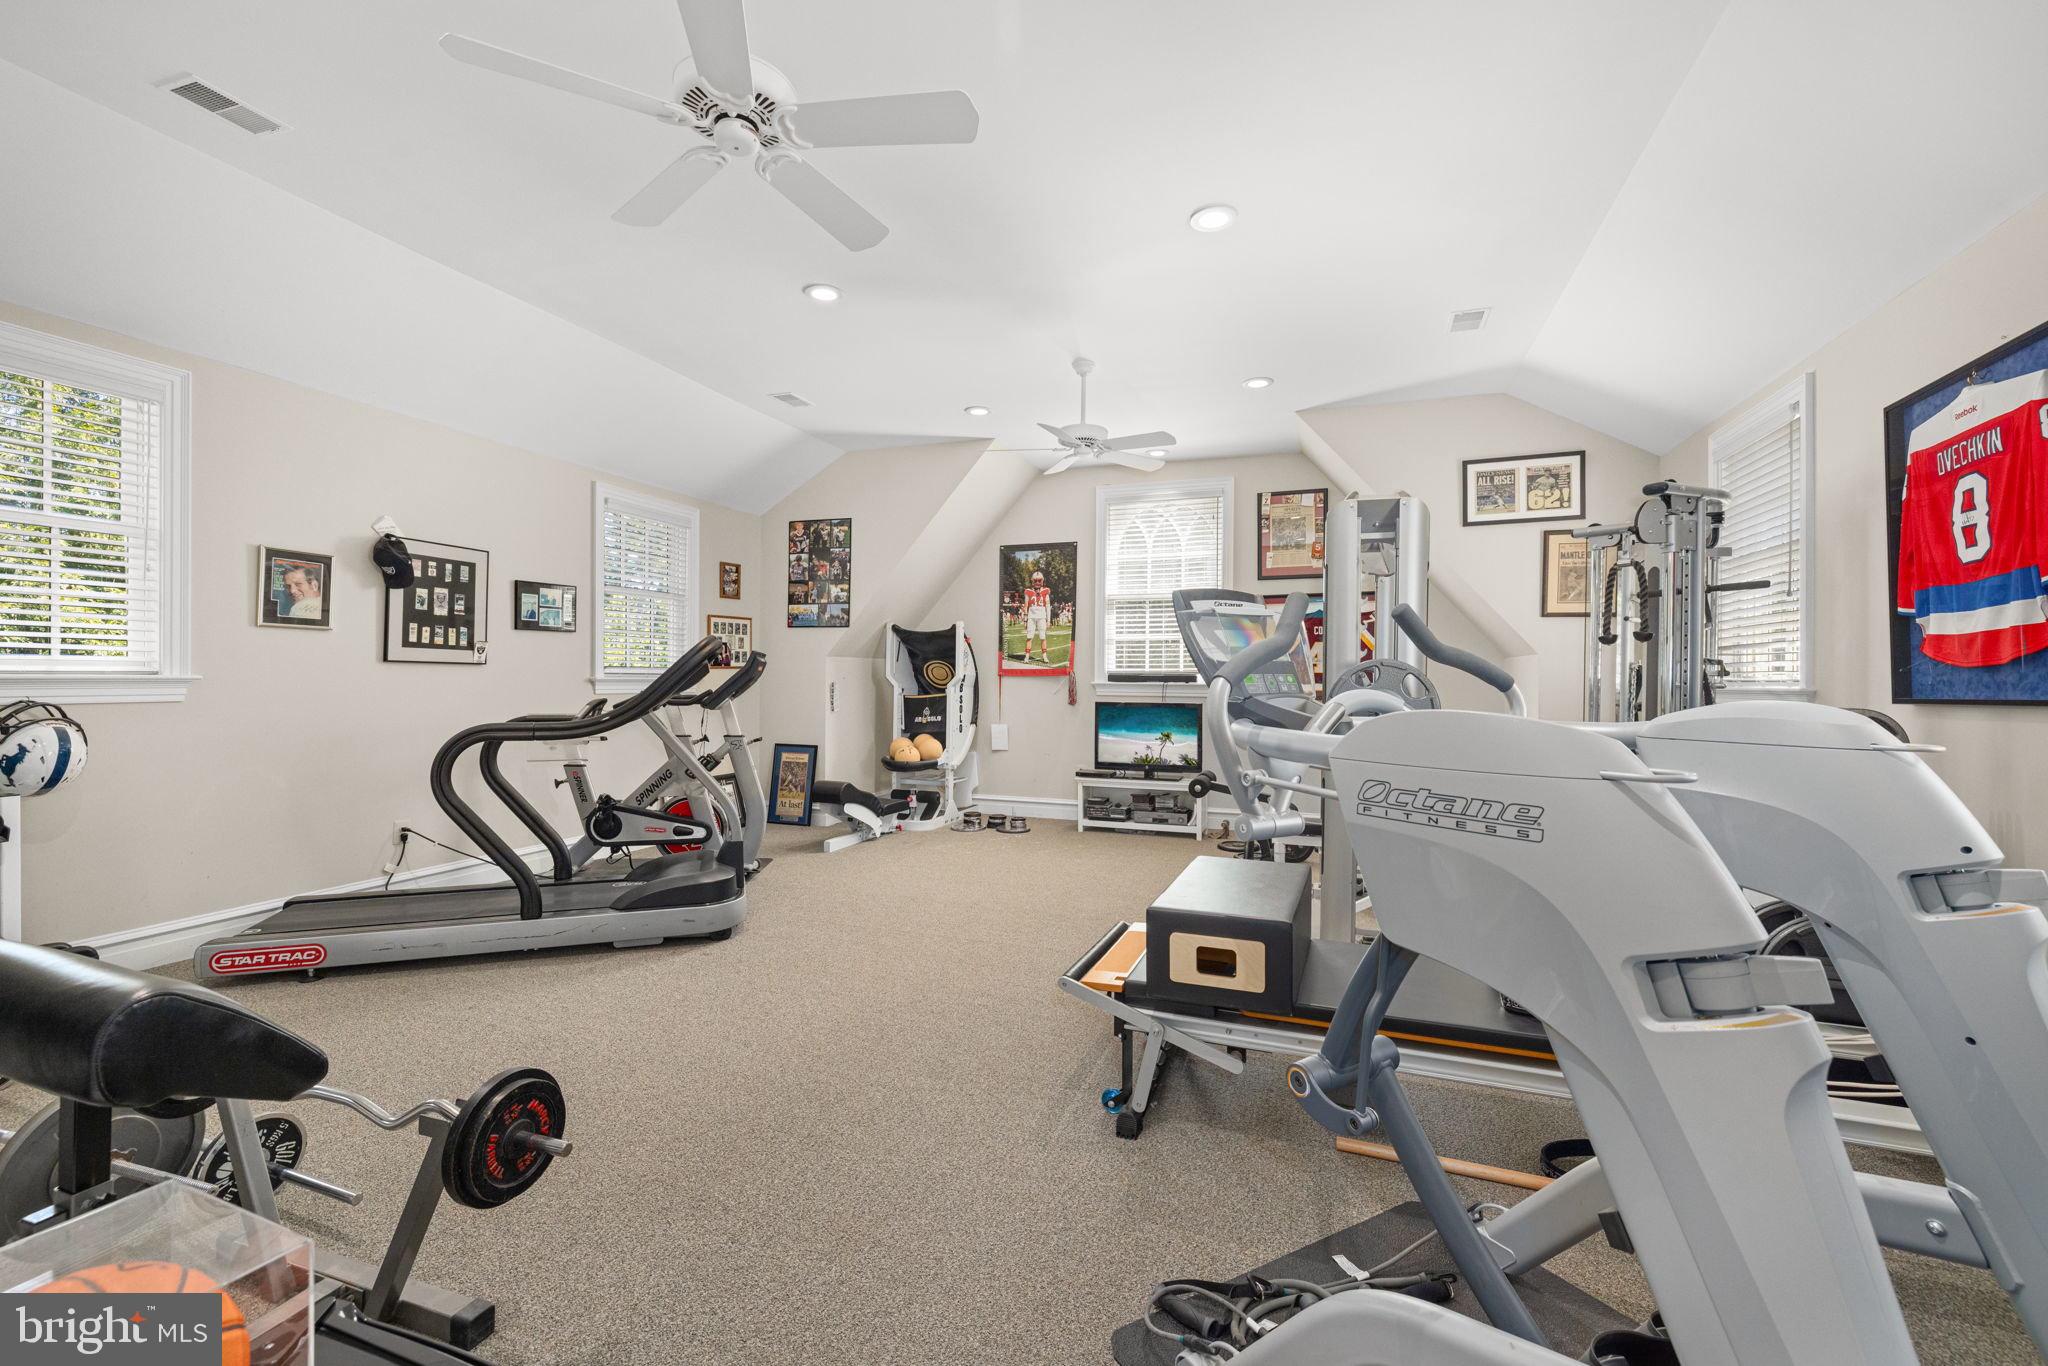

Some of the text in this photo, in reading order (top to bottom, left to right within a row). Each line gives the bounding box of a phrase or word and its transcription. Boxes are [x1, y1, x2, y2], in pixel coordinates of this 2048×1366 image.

[1955, 405, 1978, 420] Reebok
[1936, 426, 2003, 476] OVECHKIN
[1478, 475, 1514, 486] ALL RISE!
[1528, 487, 1570, 510] 62!
[1953, 471, 1992, 565] 8
[1560, 551, 1586, 560] MANTLE
[635, 769, 673, 806] SPINNING
[789, 800, 803, 808] last!
[1358, 780, 1545, 826] Octane
[1362, 806, 1530, 839] FITNESS
[220, 950, 316, 967] STAR TRAC
[265, 1129, 284, 1148] KGS
[274, 1140, 297, 1164] GOL
